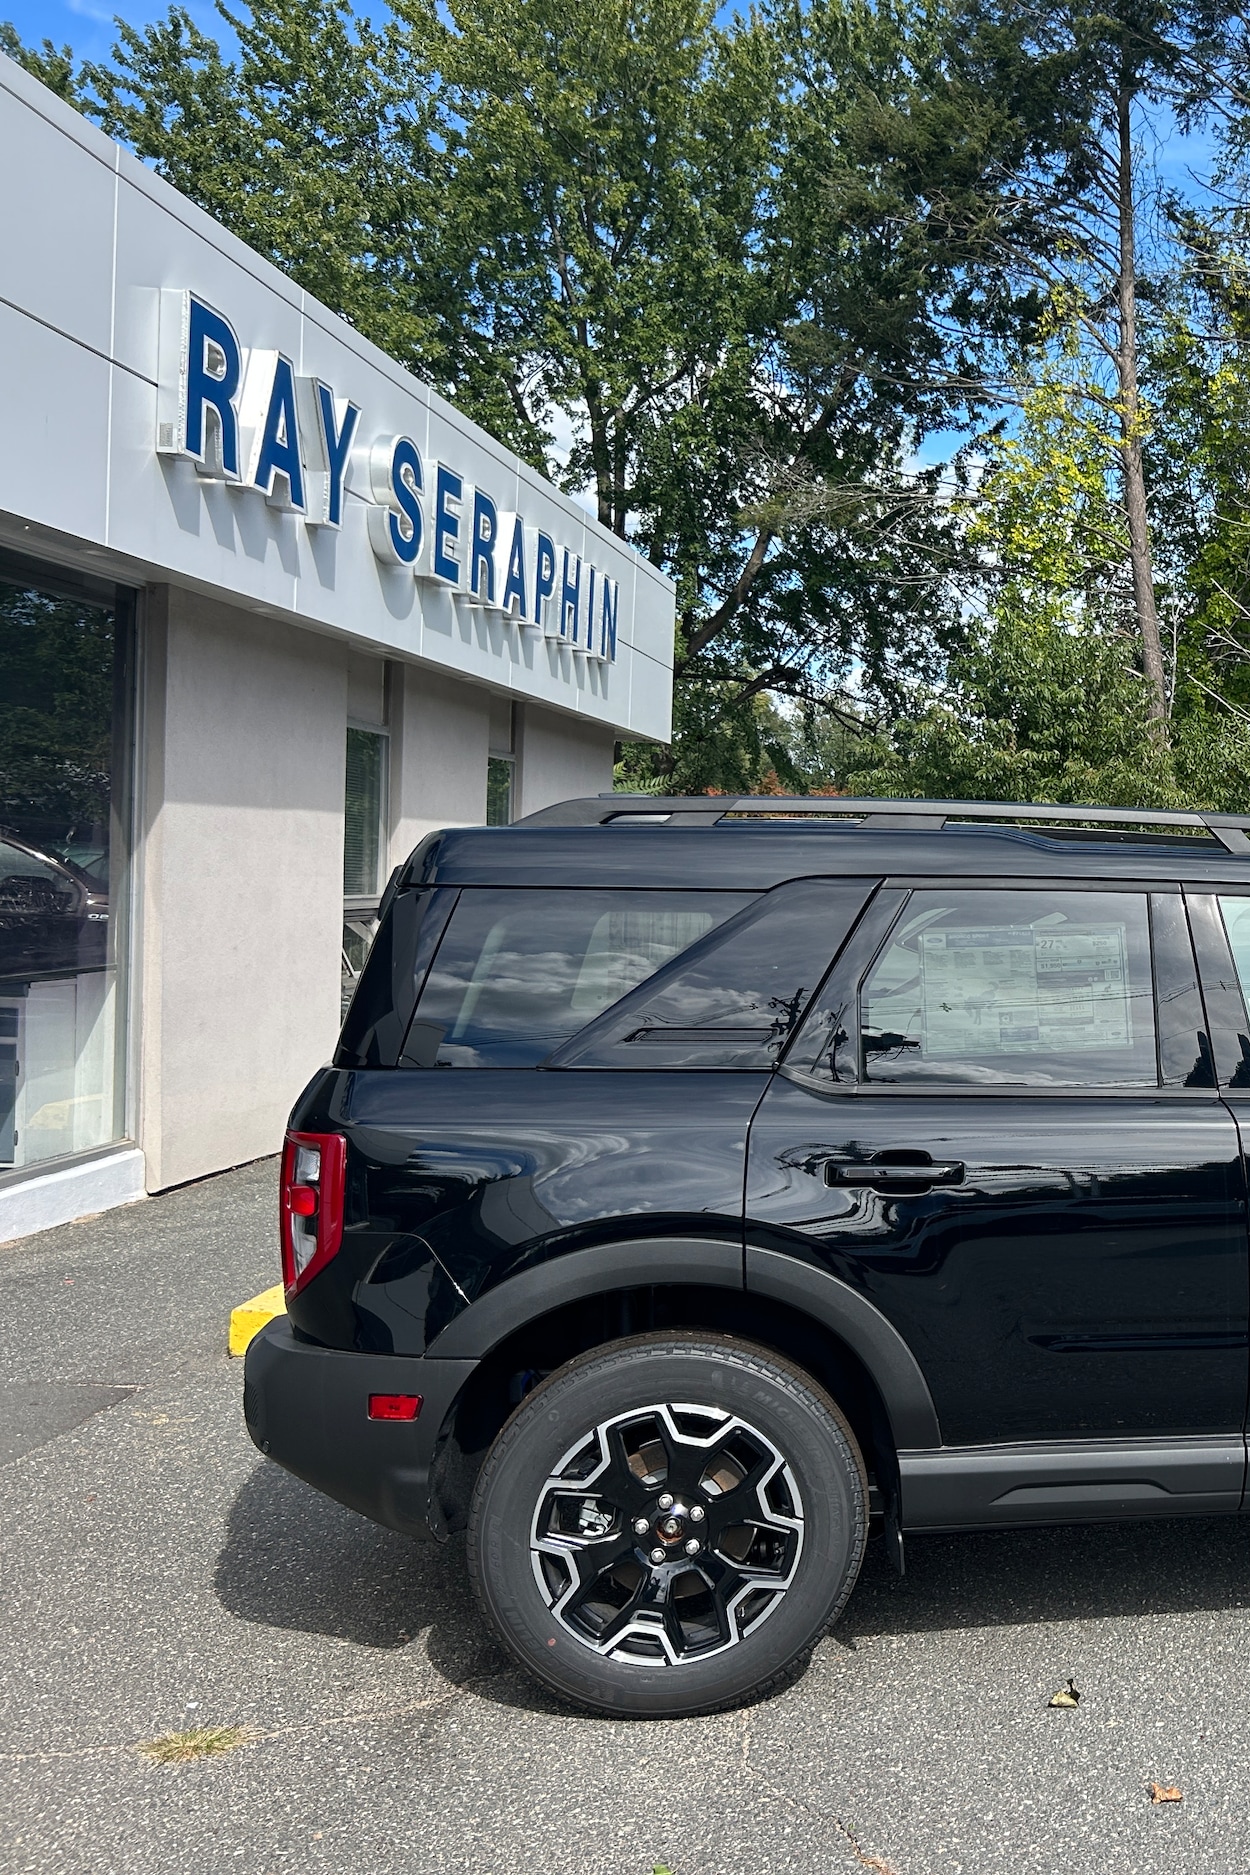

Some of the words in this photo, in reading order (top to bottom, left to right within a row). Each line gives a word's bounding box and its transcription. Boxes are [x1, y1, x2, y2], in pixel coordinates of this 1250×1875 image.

[183, 289, 362, 532] RAY
[387, 434, 620, 666] SERAPHIN
[1040, 939, 1054, 949] 27
